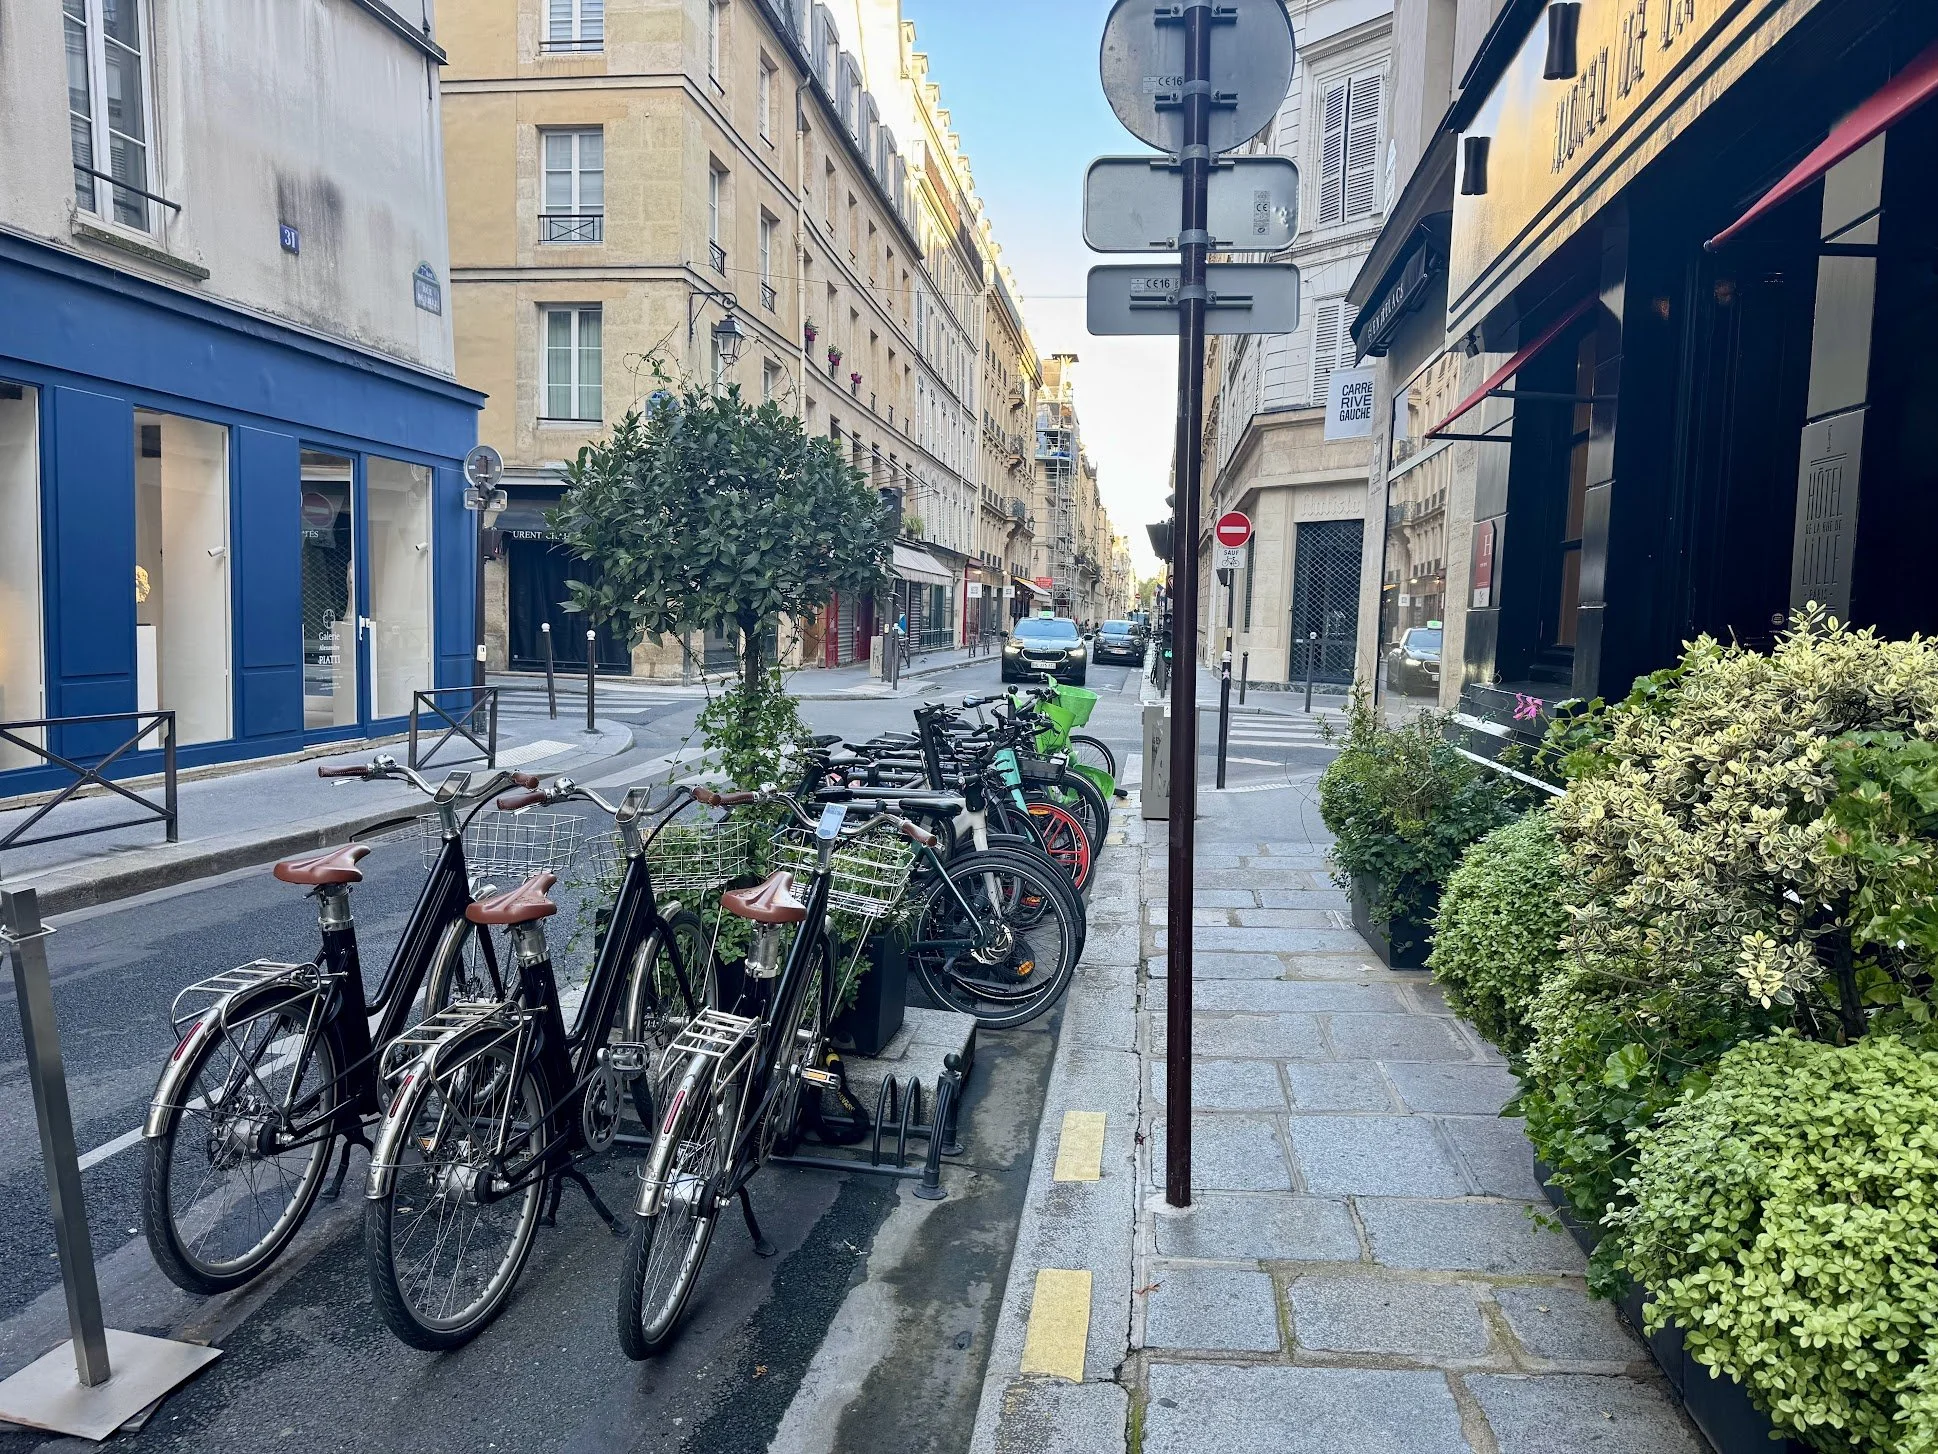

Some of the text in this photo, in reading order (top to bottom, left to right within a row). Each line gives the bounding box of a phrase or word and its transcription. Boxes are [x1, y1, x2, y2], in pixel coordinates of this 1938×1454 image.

[284, 229, 296, 248] 31
[1342, 381, 1373, 396] CARRÉ
[1341, 394, 1373, 409] RIVE
[1339, 406, 1372, 421] GAUCHE
[512, 530, 542, 539] URENT
[1483, 533, 1494, 557] H
[319, 632, 340, 640] Galerie
[318, 655, 340, 664] PIATTI
